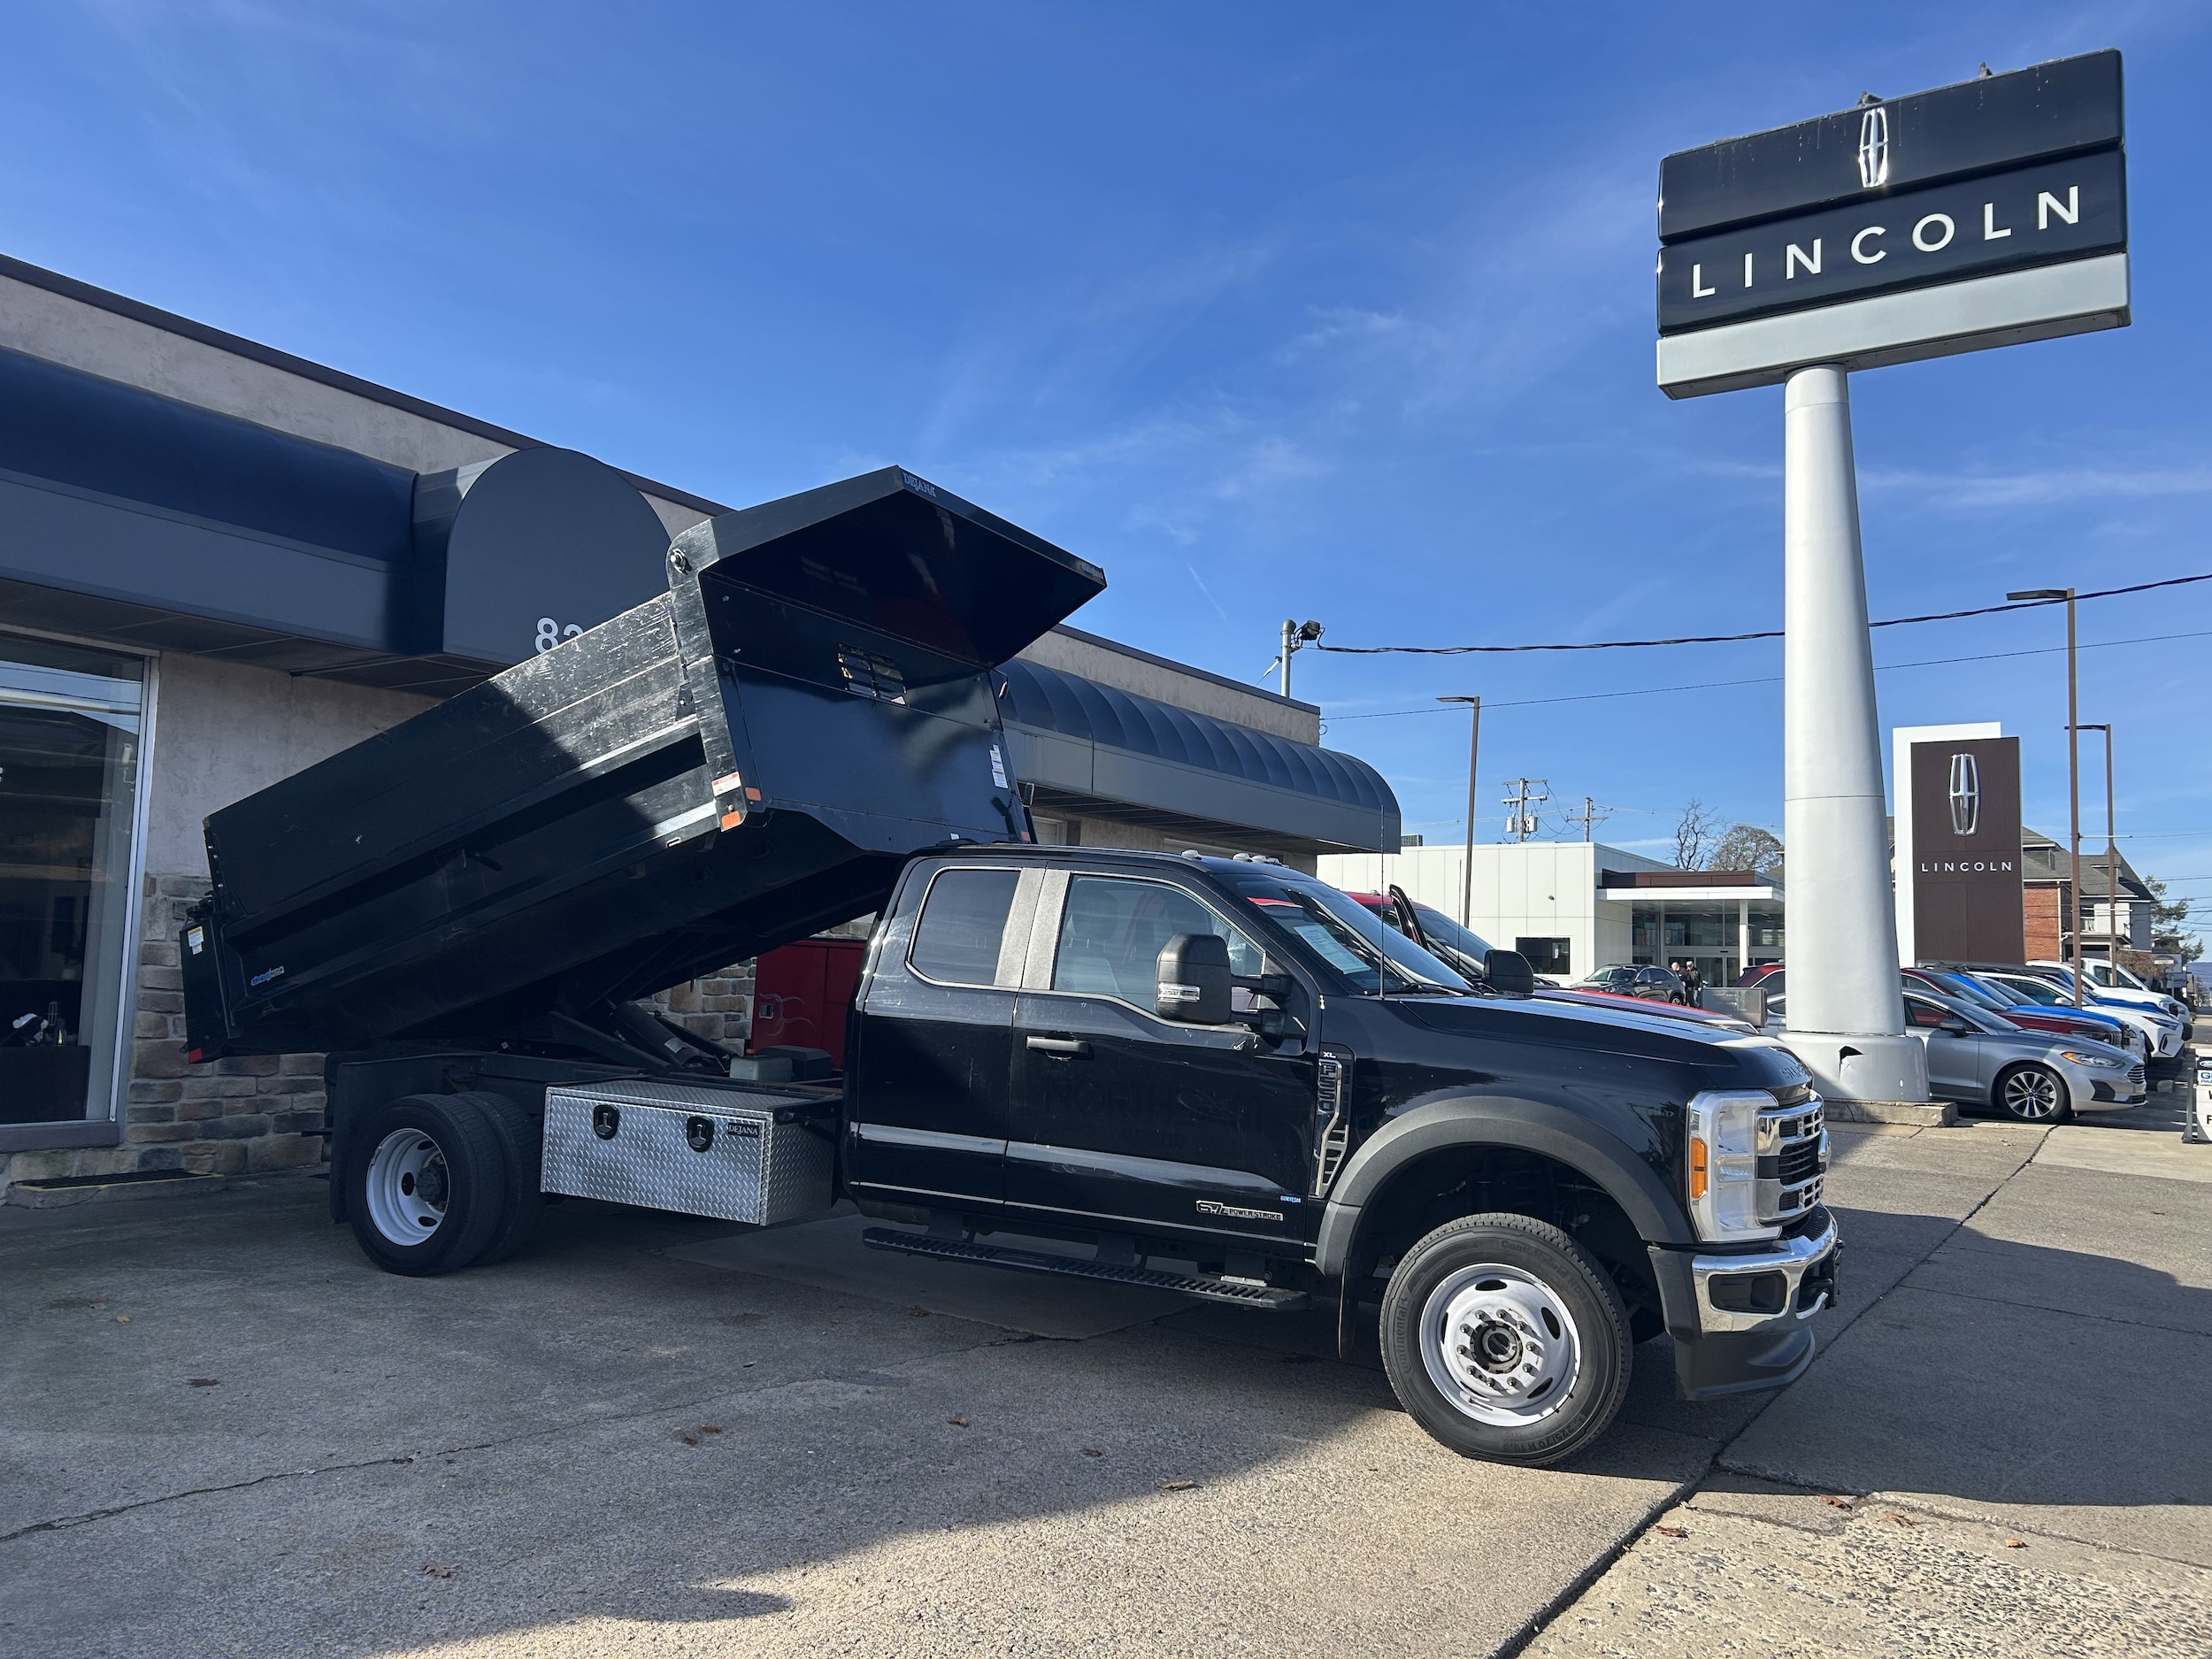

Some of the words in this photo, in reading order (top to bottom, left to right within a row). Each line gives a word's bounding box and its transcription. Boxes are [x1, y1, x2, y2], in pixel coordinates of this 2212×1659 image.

[1692, 184, 2079, 299] LINCOLN
[902, 472, 937, 497] DEJANA
[1922, 862, 2012, 872] LINCOLN
[728, 1125, 758, 1134] DEJANA
[1396, 1305, 1412, 1373] Continental
